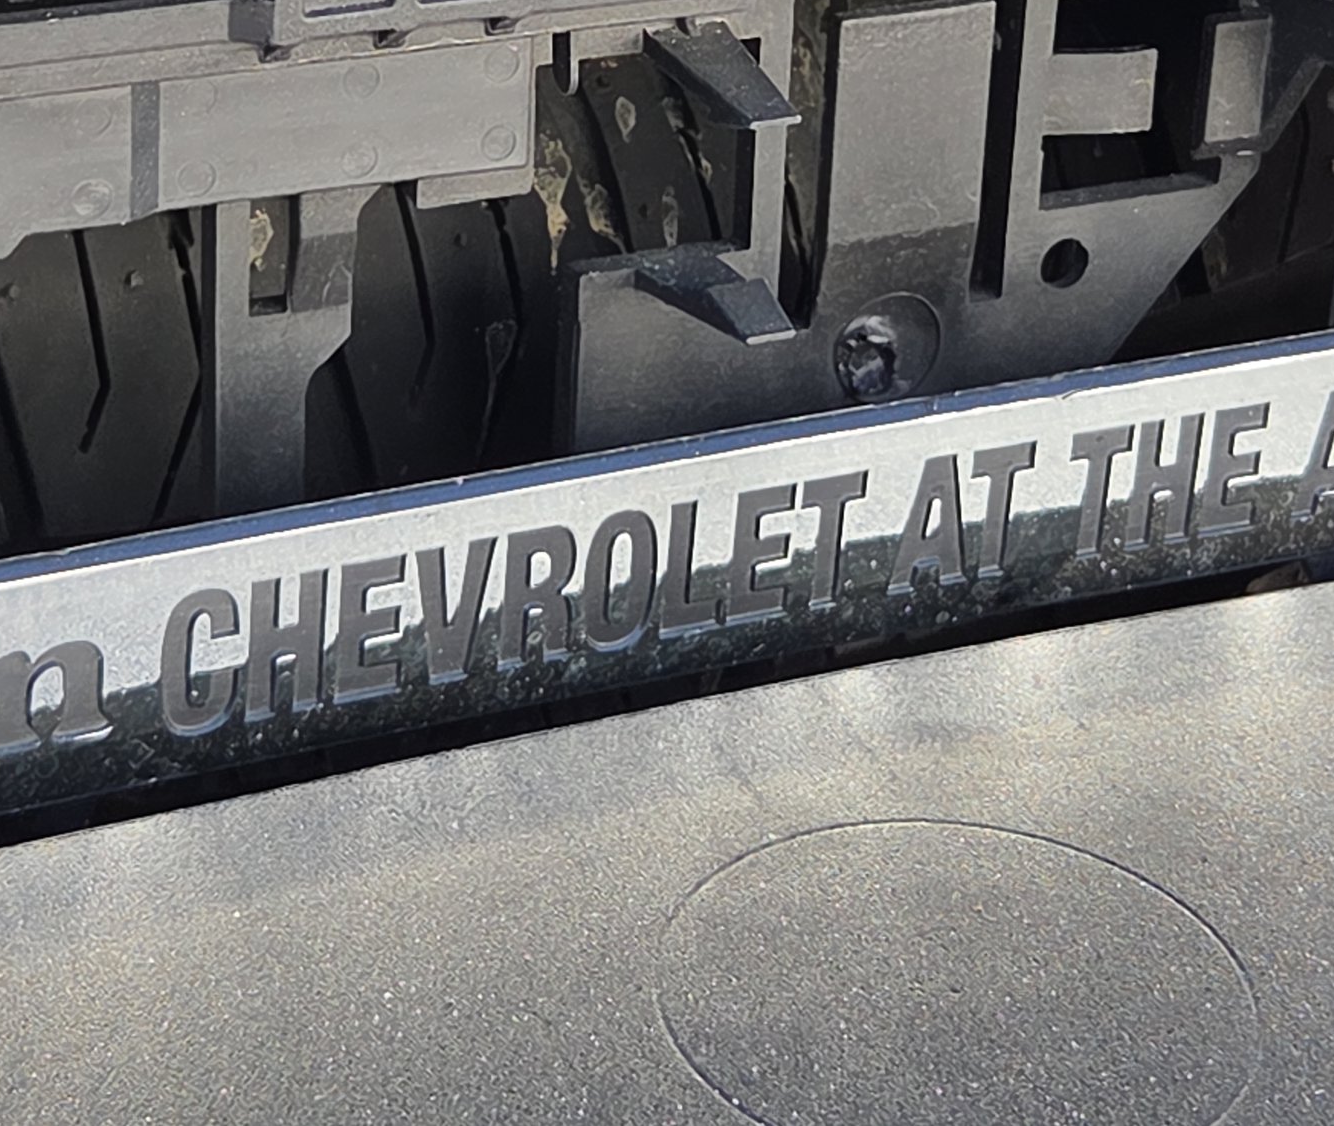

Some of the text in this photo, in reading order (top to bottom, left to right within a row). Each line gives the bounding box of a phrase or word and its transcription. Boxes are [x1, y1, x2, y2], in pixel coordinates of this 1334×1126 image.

[160, 470, 868, 736] CHEVROLET
[887, 440, 1038, 595] AT
[1071, 401, 1271, 558] THE
